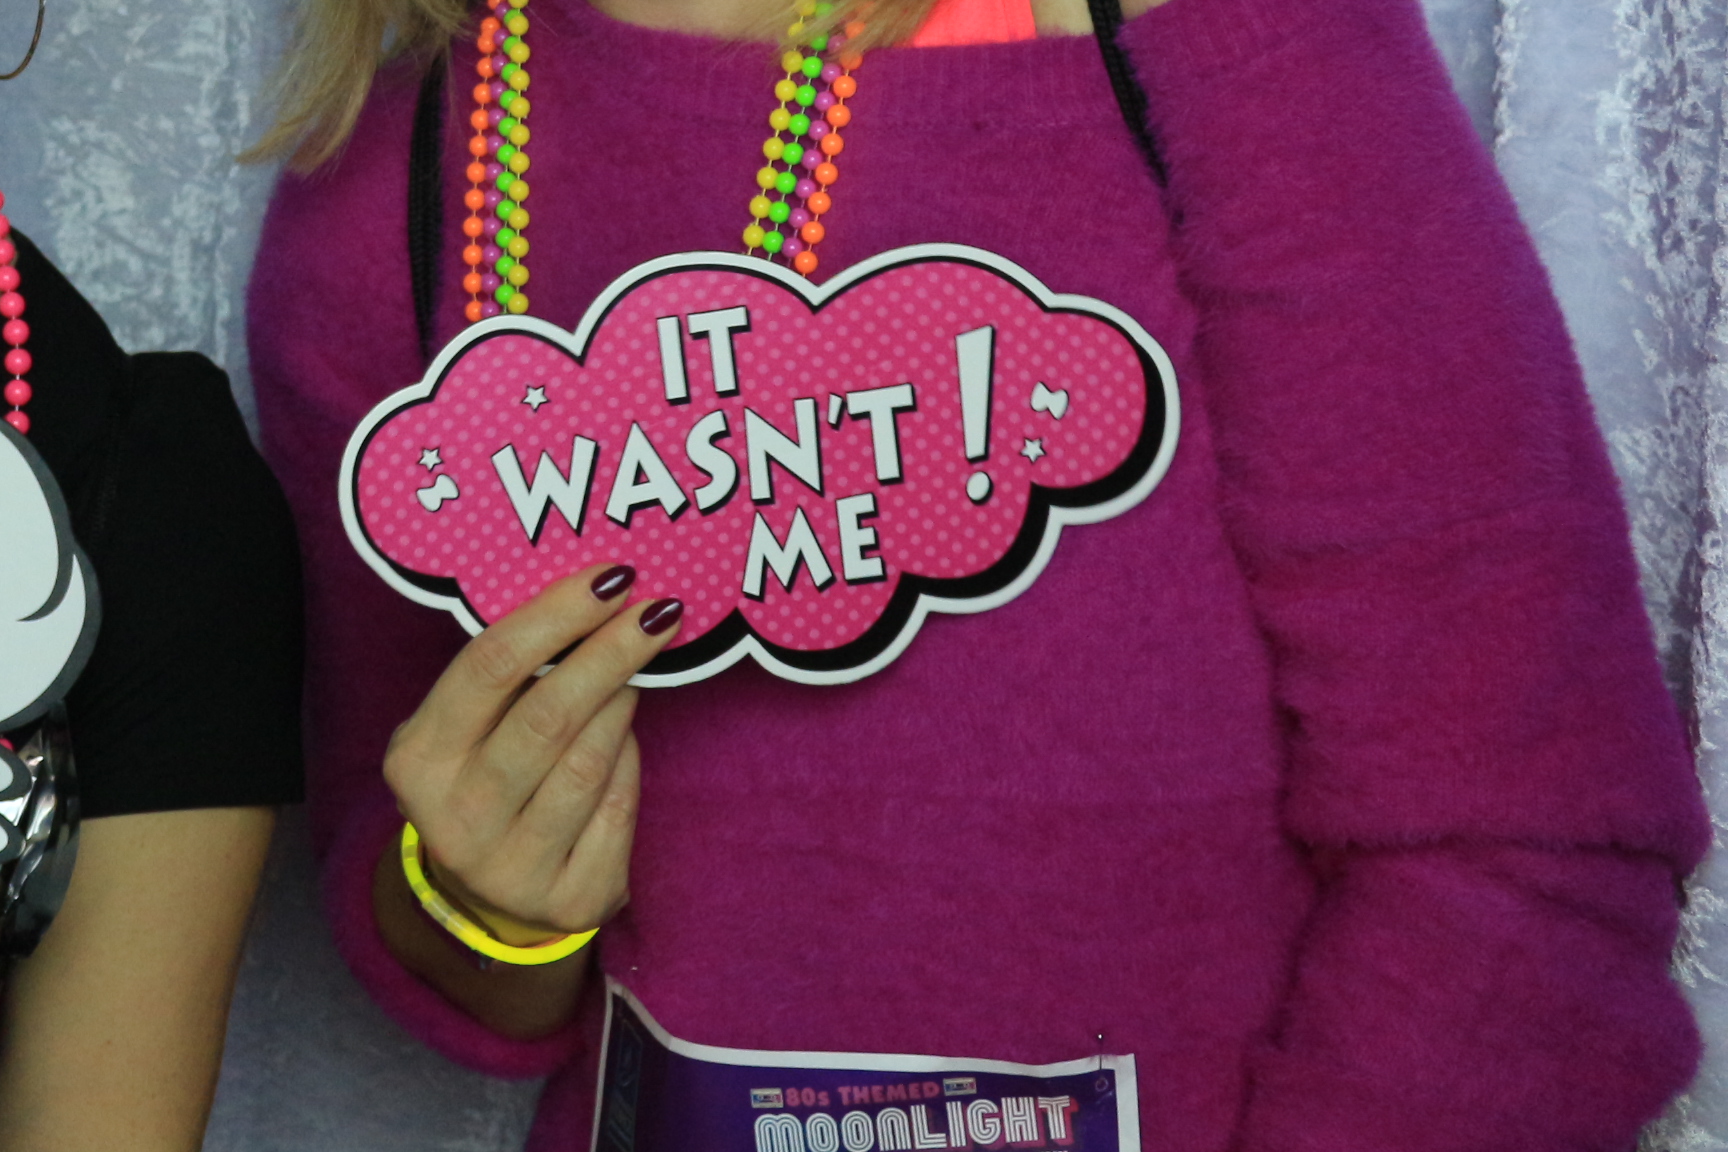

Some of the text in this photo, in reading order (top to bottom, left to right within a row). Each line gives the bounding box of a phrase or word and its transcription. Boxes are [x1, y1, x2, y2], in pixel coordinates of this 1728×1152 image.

[656, 306, 749, 401] IT
[490, 383, 917, 545] WASN'T
[740, 493, 886, 598] ME
[754, 1095, 1071, 1152] MOONLIGHT
[785, 1081, 940, 1107] 80s THEMED
